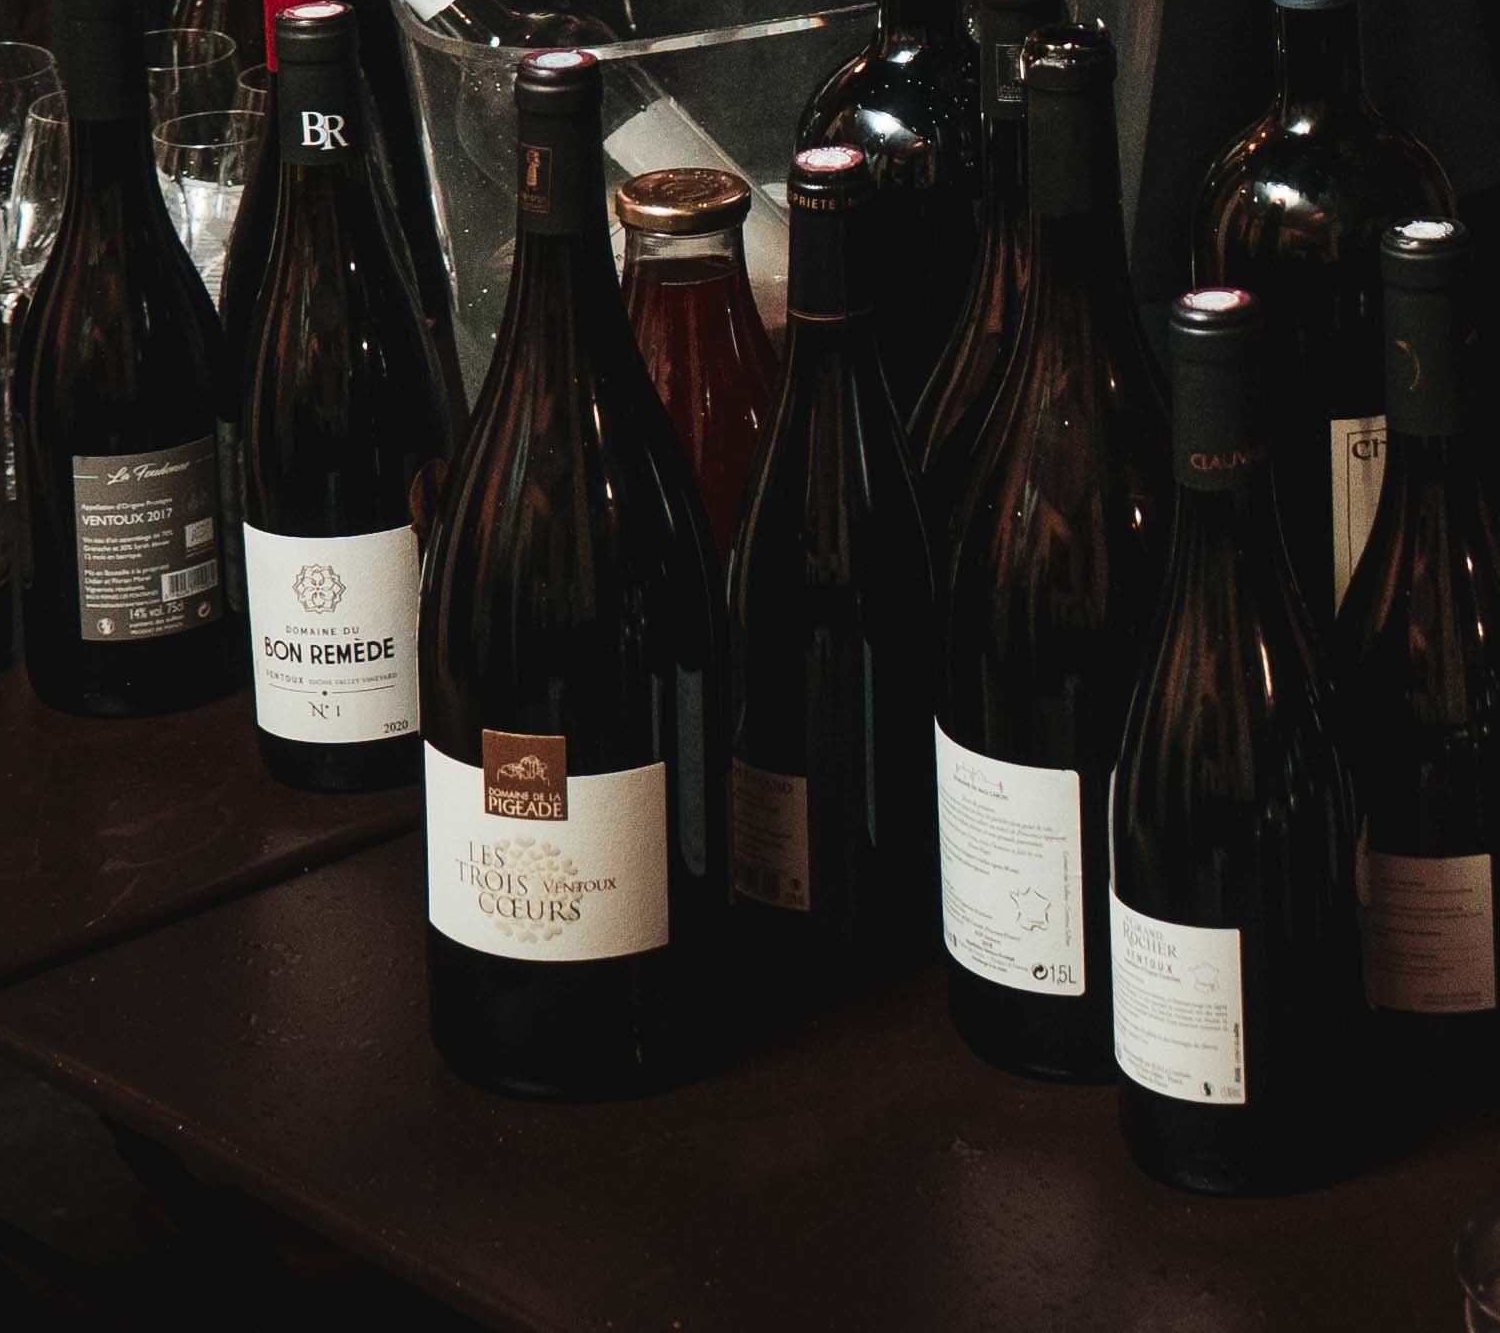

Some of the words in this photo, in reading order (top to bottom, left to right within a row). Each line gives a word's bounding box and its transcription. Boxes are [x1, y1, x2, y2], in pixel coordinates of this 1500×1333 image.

[301, 111, 349, 151] BR
[82, 514, 144, 526] VENTOUX
[146, 507, 173, 523] 2017
[285, 625, 337, 636] DOMAINE
[343, 626, 360, 636] DU
[264, 636, 302, 663] BON
[310, 636, 396, 665] REMÈDE
[266, 669, 304, 684] VENTOUX
[384, 719, 409, 733] 2020
[488, 786, 530, 800] DOMAINE
[533, 792, 547, 801] DE
[549, 792, 562, 802] LA
[488, 796, 564, 818] PIGEADE
[468, 841, 505, 868] LES
[455, 858, 529, 896] TROIS
[478, 892, 583, 922] CŒURS
